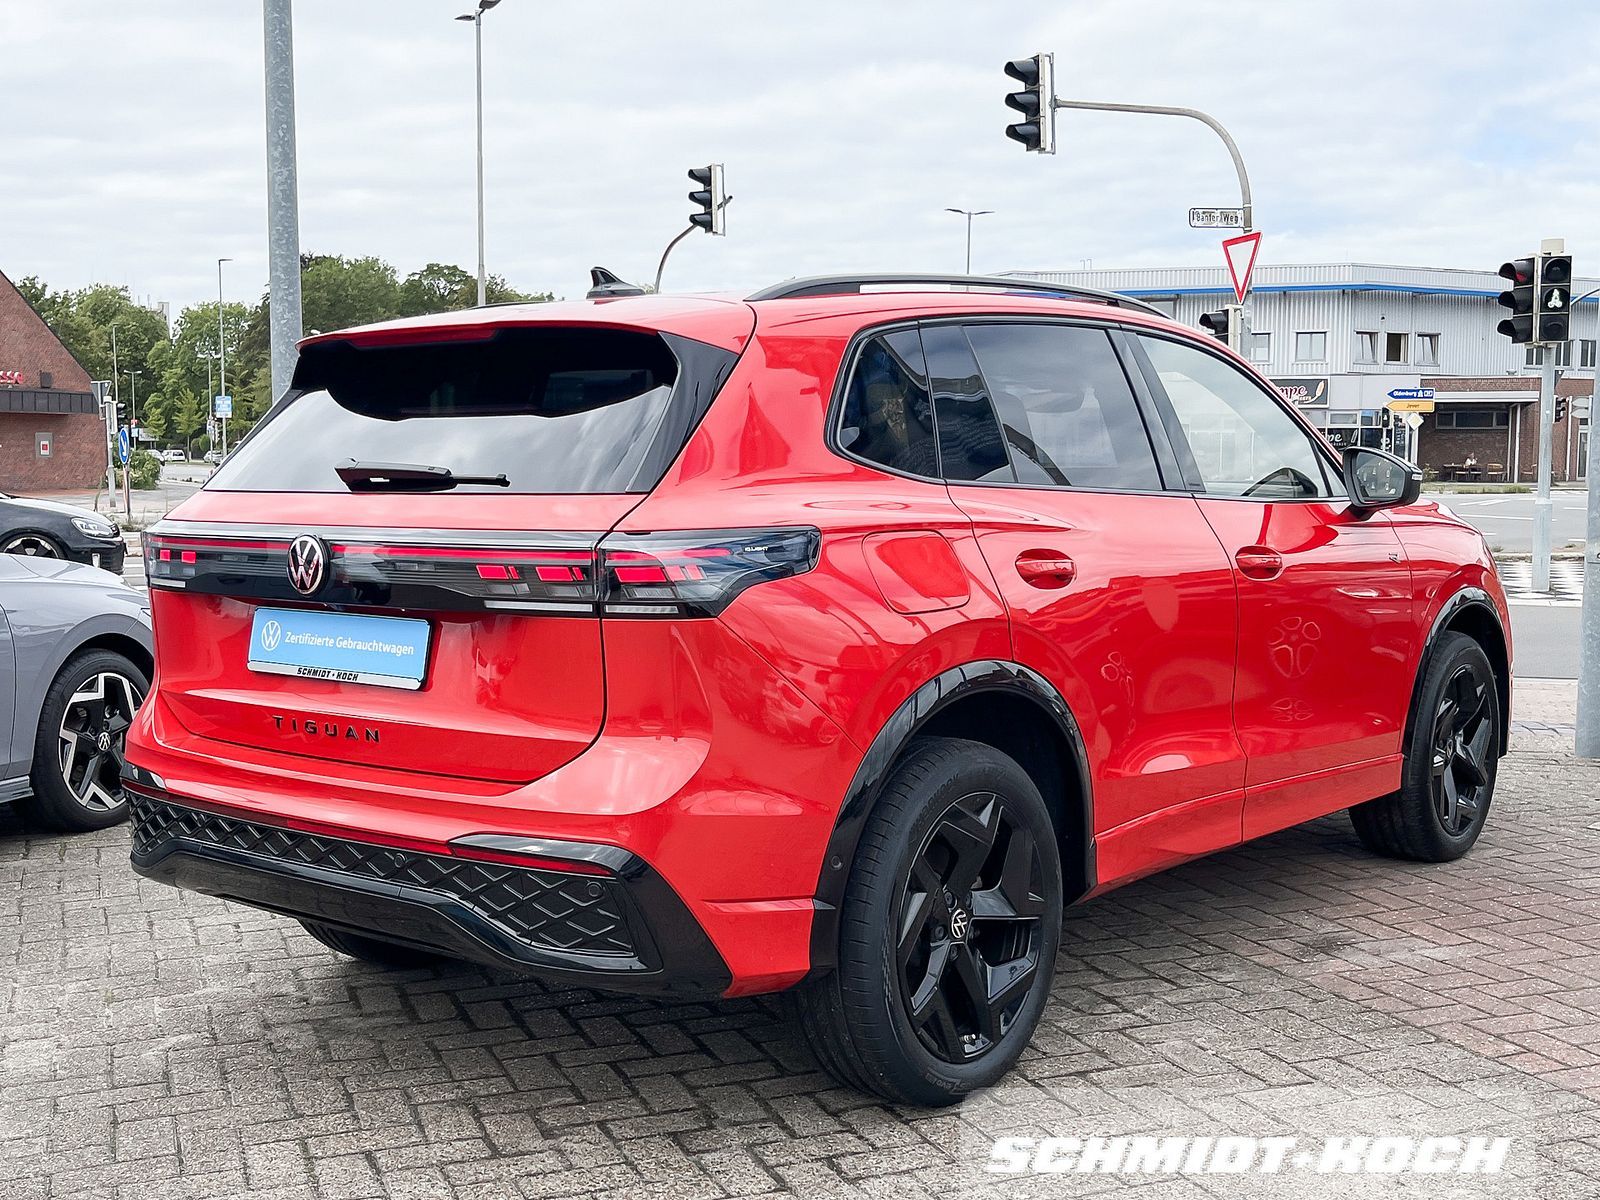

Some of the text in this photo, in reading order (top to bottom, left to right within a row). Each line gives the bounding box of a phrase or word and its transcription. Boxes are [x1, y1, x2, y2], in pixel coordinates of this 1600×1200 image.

[1222, 213, 1239, 224] Weg
[284, 631, 415, 657] Zertifizierte Gebrauchtwagen
[296, 667, 332, 679] SCHMIDT
[336, 671, 360, 682] KOCH
[272, 715, 381, 743] TIGUAN
